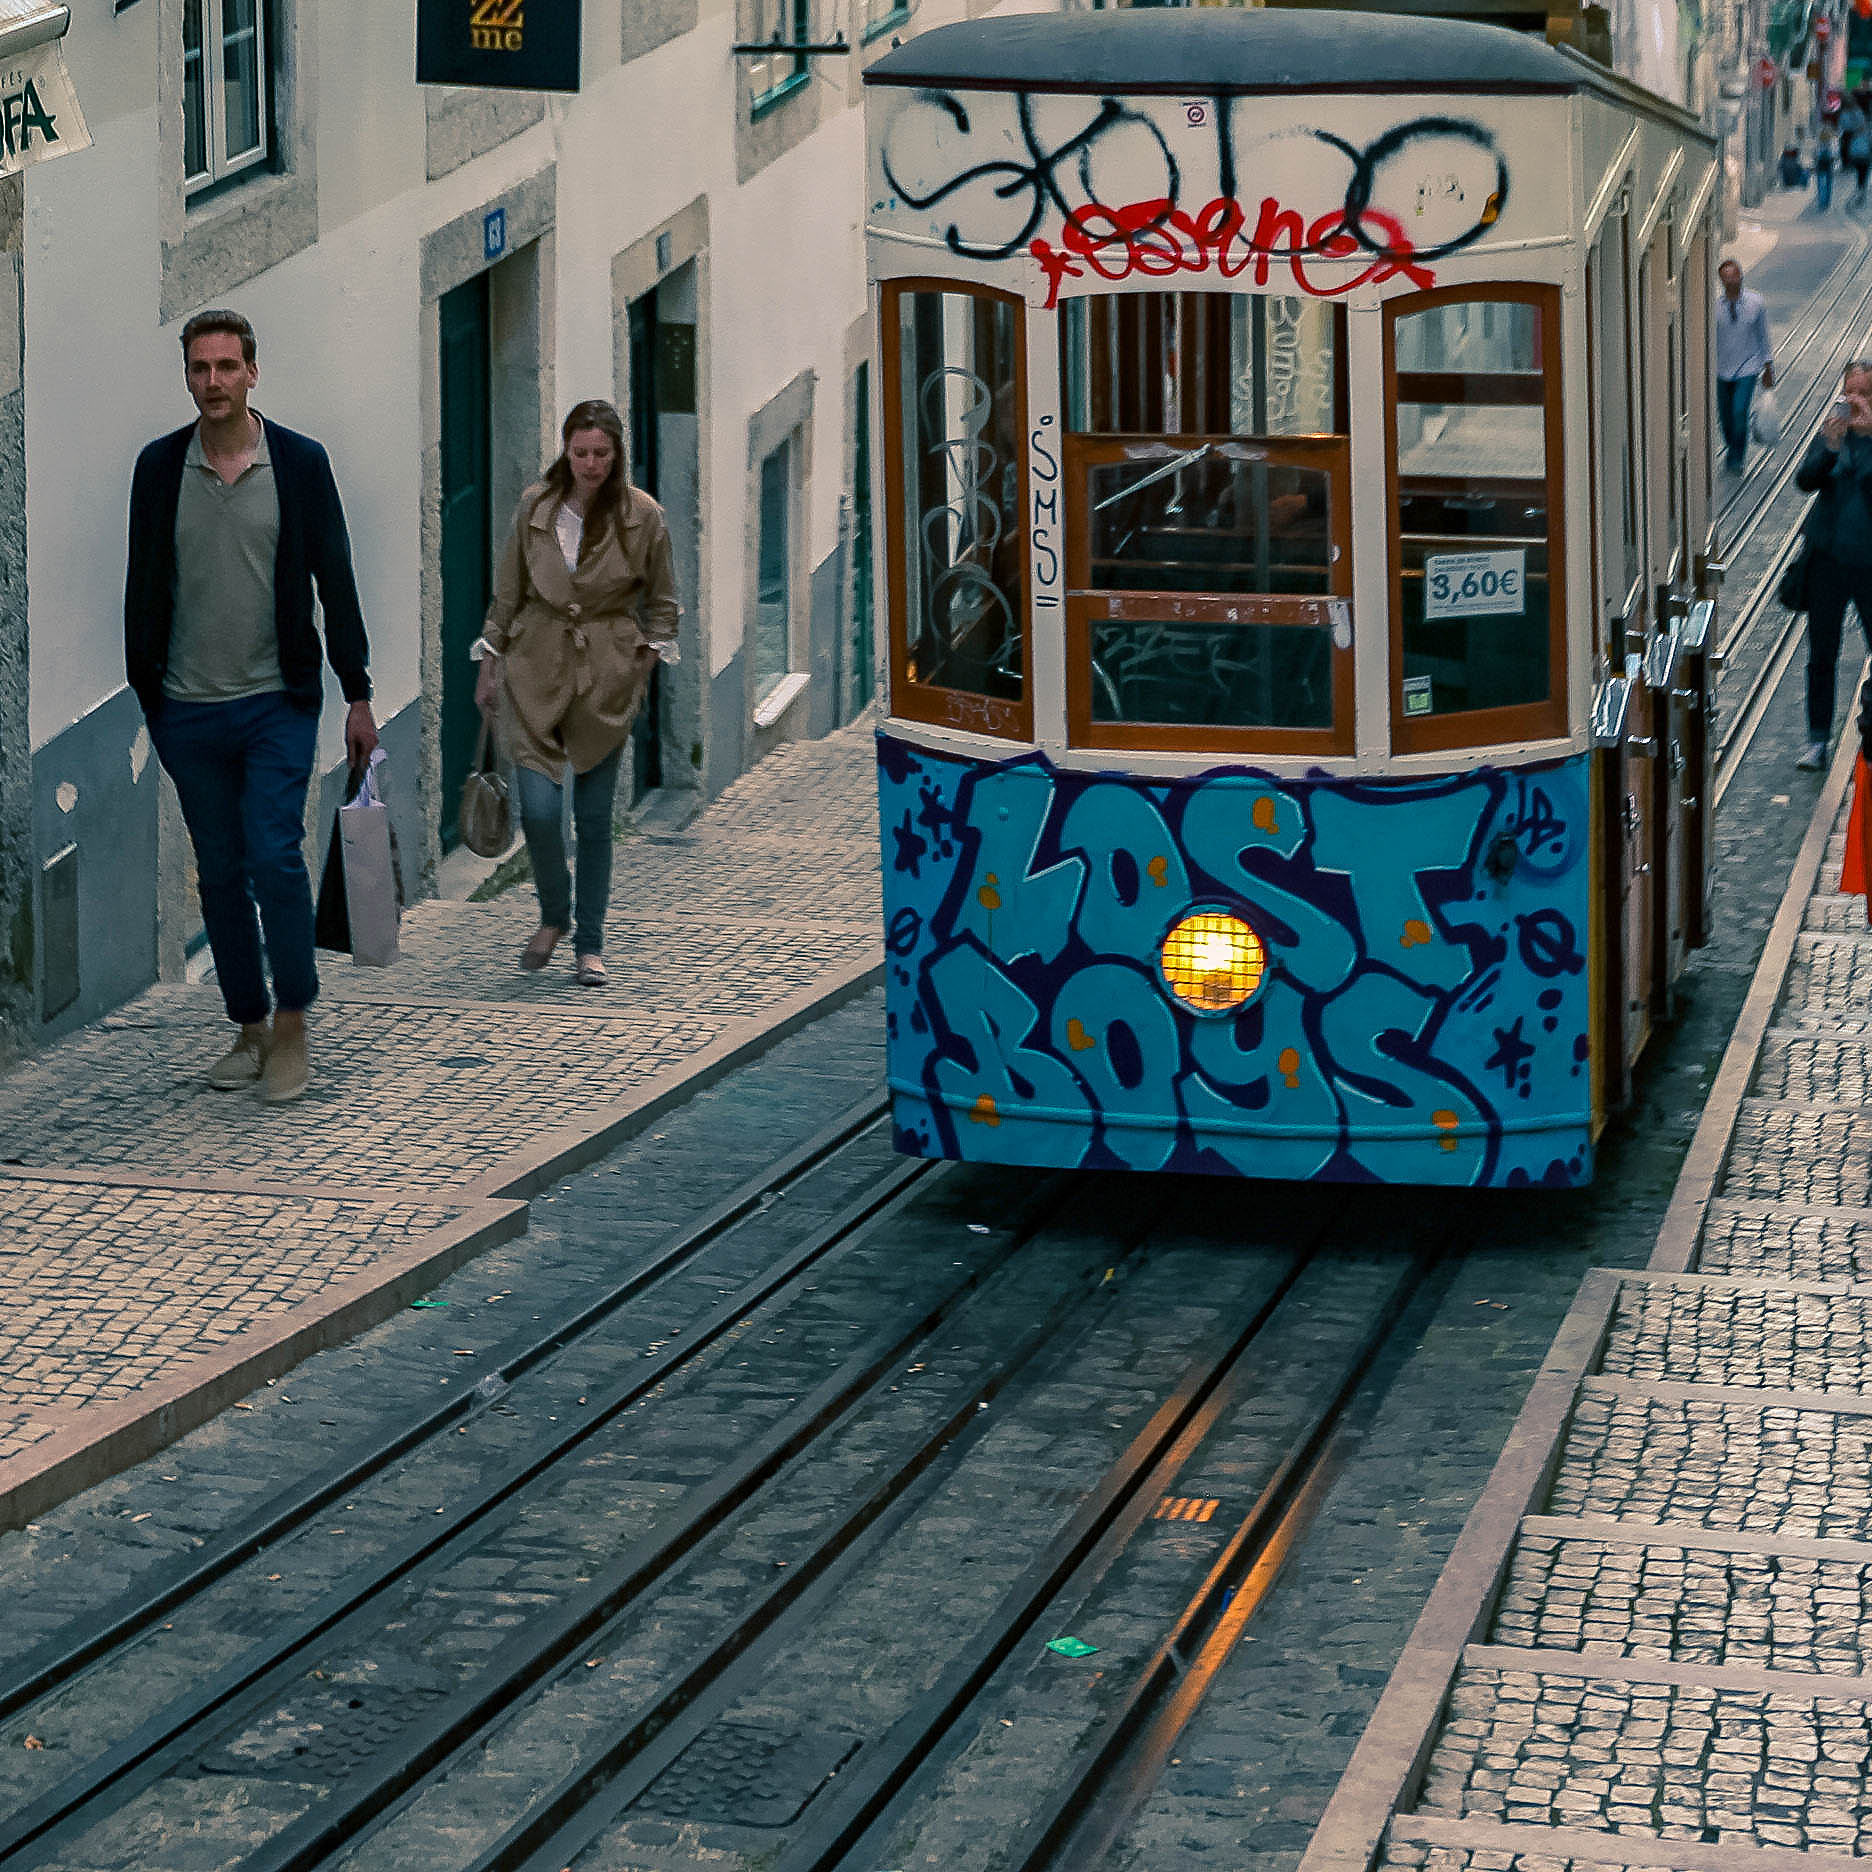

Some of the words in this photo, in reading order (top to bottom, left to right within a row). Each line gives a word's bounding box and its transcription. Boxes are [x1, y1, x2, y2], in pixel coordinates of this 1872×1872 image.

[1432, 568, 1518, 604] 3,60€
[938, 754, 1506, 996] LOST
[921, 960, 1500, 1188] BOYS
